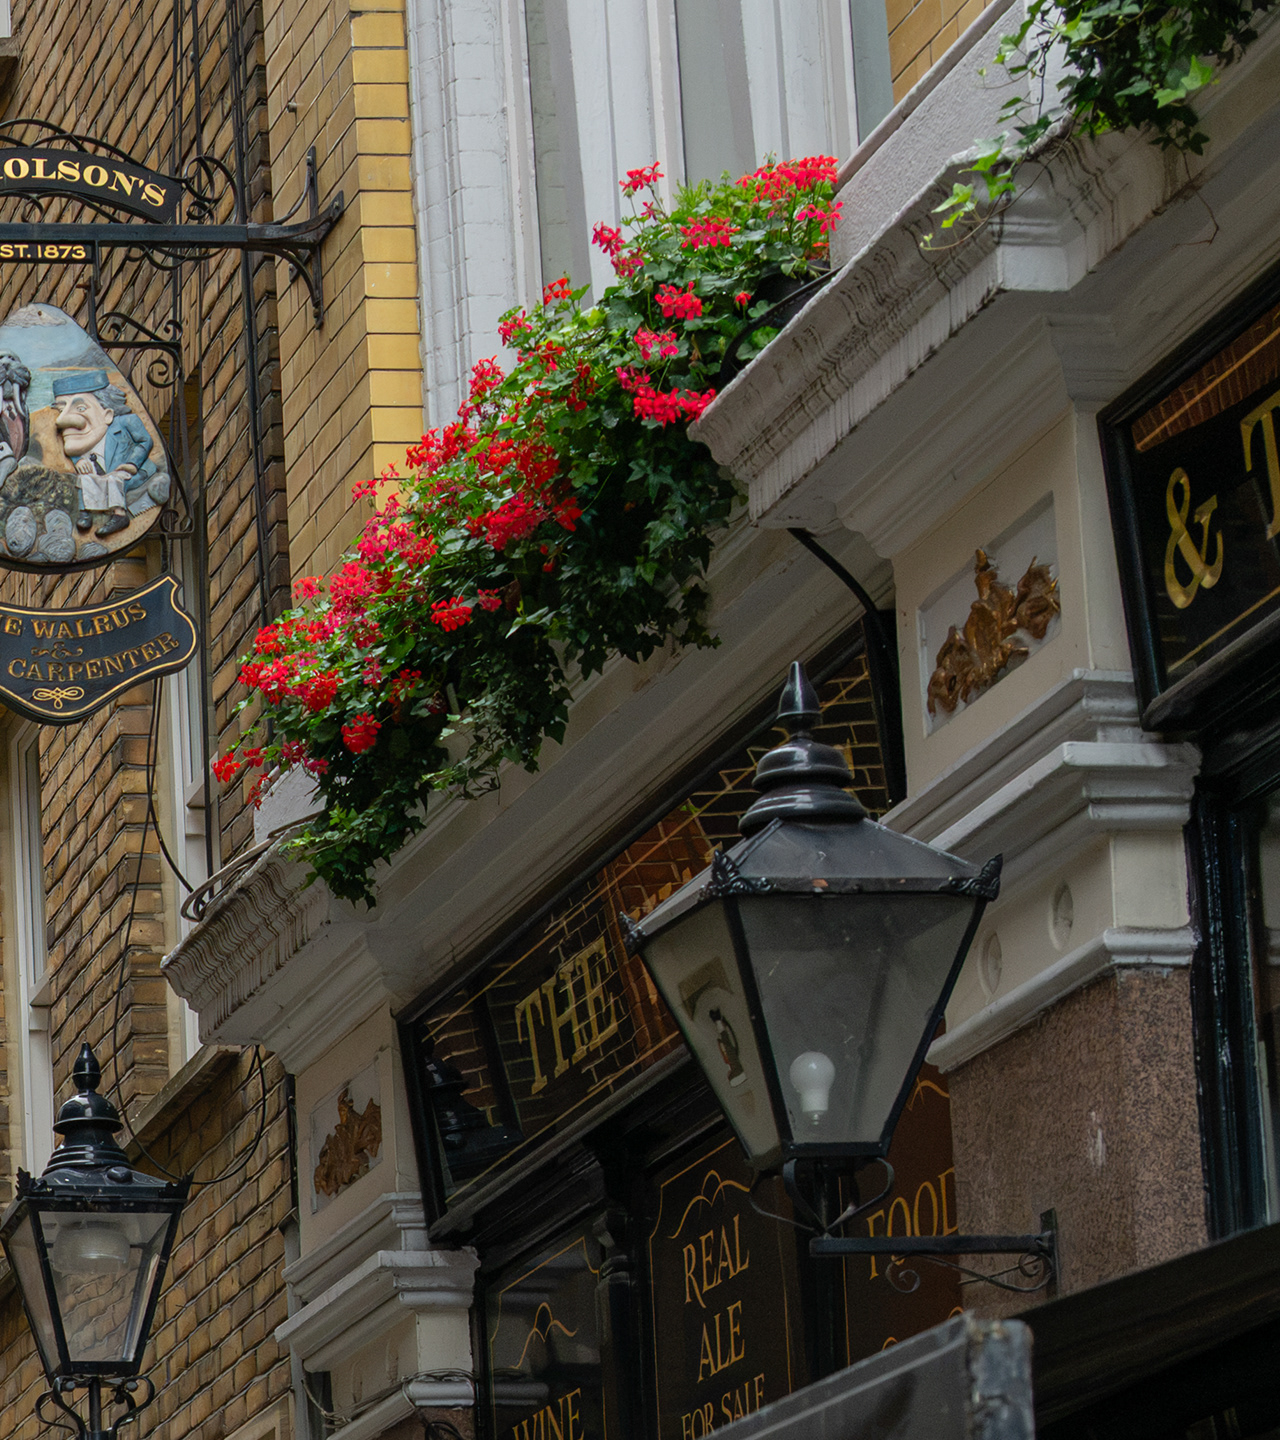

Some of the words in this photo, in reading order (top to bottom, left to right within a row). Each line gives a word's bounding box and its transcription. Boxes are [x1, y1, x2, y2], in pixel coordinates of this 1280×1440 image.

[37, 244, 87, 260] 1873
[1164, 466, 1224, 610] &
[7, 631, 180, 682] CARPENTER
[30, 601, 148, 639] WALRUS
[514, 936, 618, 1095] THE
[682, 1213, 750, 1309] REAL
[696, 1300, 746, 1384] ALE
